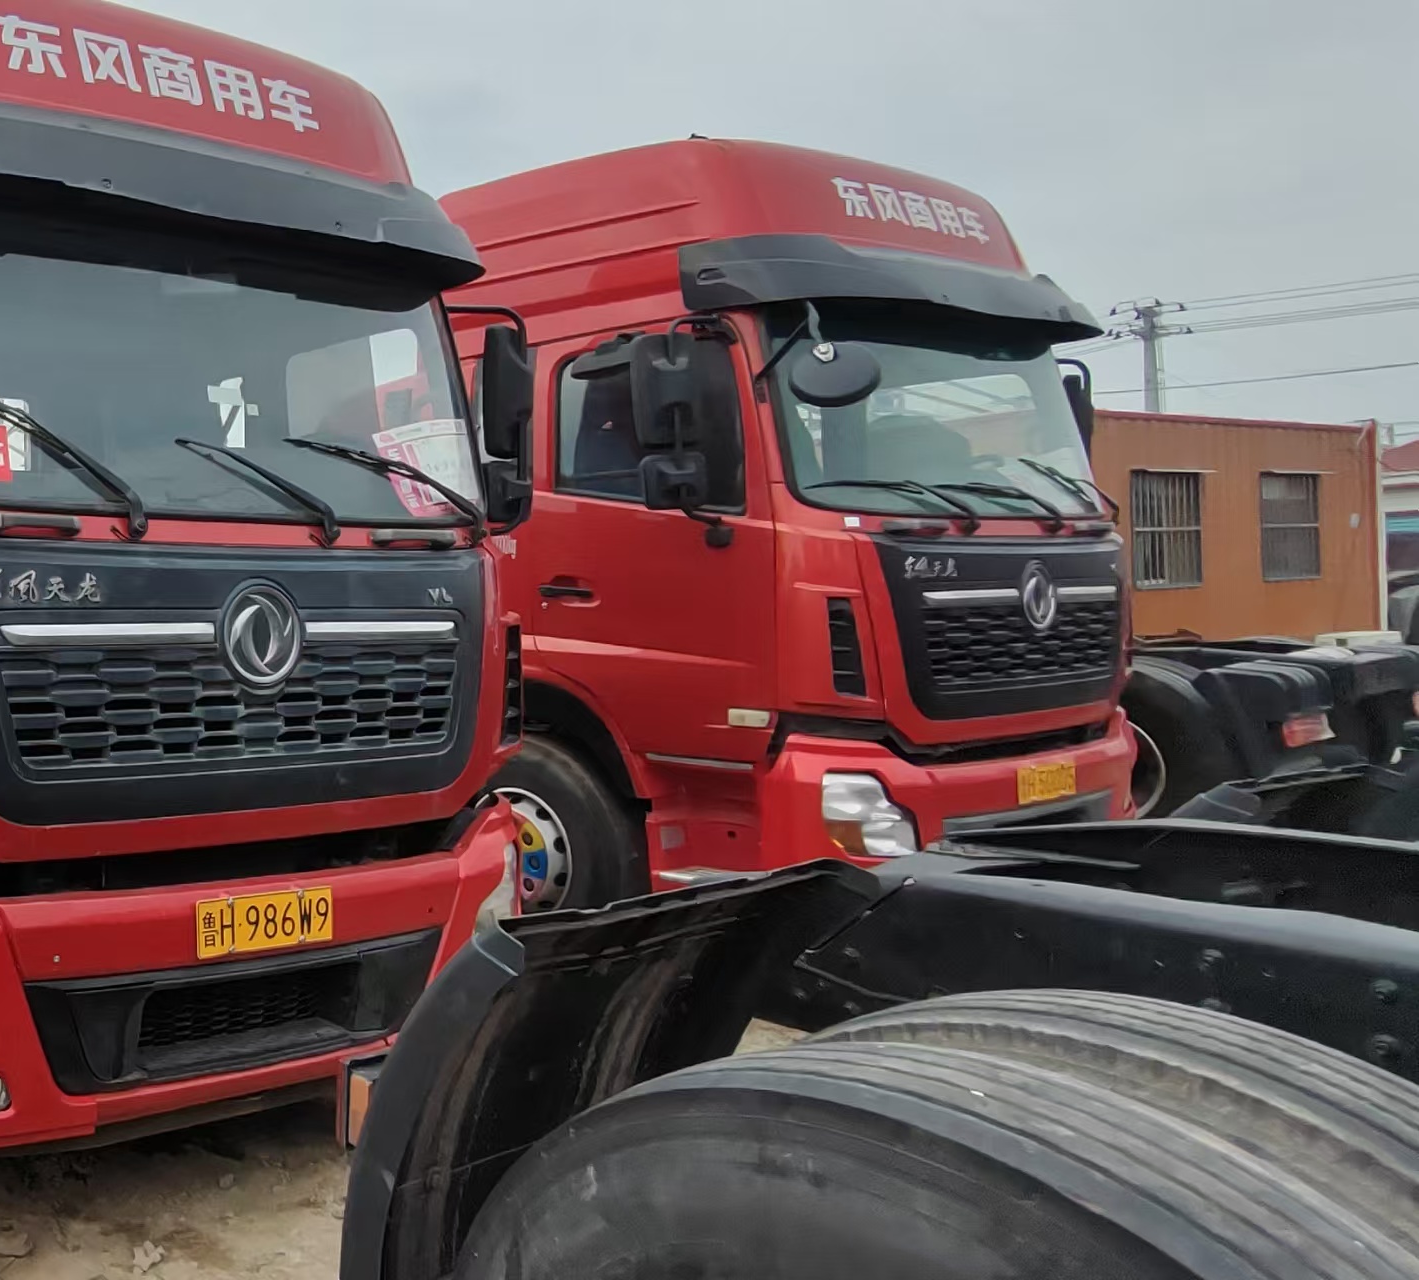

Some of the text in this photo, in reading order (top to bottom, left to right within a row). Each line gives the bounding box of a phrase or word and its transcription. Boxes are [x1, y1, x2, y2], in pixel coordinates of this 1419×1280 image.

[830, 176, 990, 245] 东风商用车
